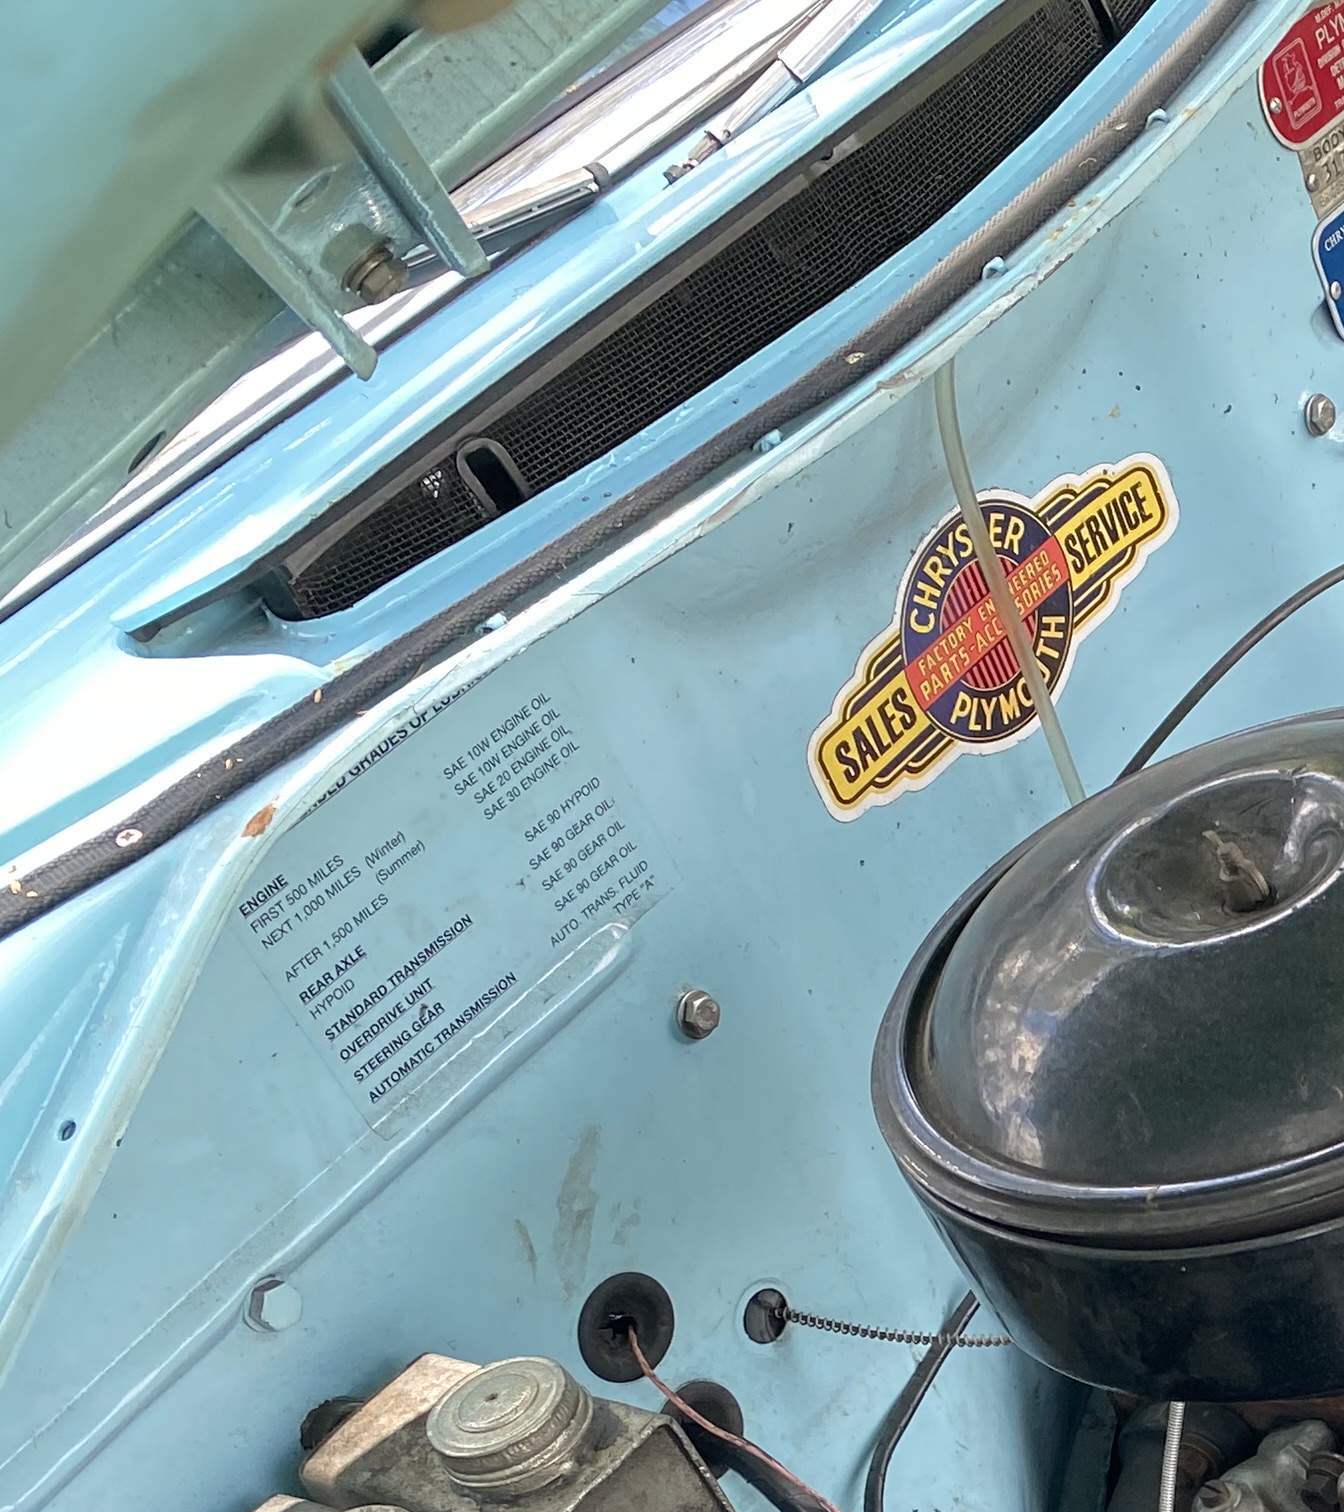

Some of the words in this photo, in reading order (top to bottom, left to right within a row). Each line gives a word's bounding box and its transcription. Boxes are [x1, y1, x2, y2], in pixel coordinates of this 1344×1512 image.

[1064, 481, 1153, 574] SERVICE
[911, 512, 1025, 634] CHRYSER
[917, 618, 974, 673] FACTORY
[978, 548, 1050, 623] ENNEERED
[443, 756, 468, 780] SAE
[467, 737, 491, 760] 10W
[490, 705, 532, 743] ENGINE
[531, 693, 551, 710] OIL
[454, 772, 478, 795] SAE
[478, 753, 501, 776] 10W
[501, 721, 542, 759] ENGINE
[541, 709, 561, 726] OIL
[474, 781, 498, 804] SAE
[496, 770, 511, 786] 20
[510, 737, 552, 775] ENGINE
[550, 725, 570, 743] OIL
[834, 688, 918, 784] SALES
[483, 797, 507, 820] SAE
[506, 786, 520, 802] 30
[520, 754, 561, 791] ENGINE
[560, 741, 580, 758] OIL
[524, 820, 548, 843] SAE
[546, 809, 561, 825] 90
[560, 777, 601, 814] HYPOID
[376, 840, 425, 885] (Summer)
[529, 848, 552, 871] SAE
[551, 837, 566, 853] 90
[565, 812, 596, 841] GEAR
[594, 799, 614, 817] OIL
[541, 869, 565, 891] SAE
[563, 857, 578, 873] 90
[577, 833, 608, 861] GEAR
[606, 820, 626, 838] OIL
[238, 874, 288, 918] ENGINE
[250, 901, 285, 933] FIRST
[285, 884, 308, 906] 500
[307, 855, 344, 888] MILES
[261, 918, 293, 949] NEXT
[295, 895, 325, 923] 1,000
[325, 866, 361, 899] MILES
[364, 831, 406, 869] (Winter)
[554, 889, 578, 912] SAE
[575, 878, 590, 894] 90
[589, 854, 620, 883] GEAR
[618, 841, 638, 858] OIL
[580, 887, 619, 920] TRANS.
[618, 860, 648, 890] FLUID
[612, 888, 641, 915] TYPE
[285, 947, 323, 982] AFTER
[323, 922, 353, 949] 1,500
[353, 894, 389, 926] MILES
[300, 972, 334, 1005] REAR
[337, 945, 366, 978] AXLE
[325, 985, 388, 1041] STANDARD
[387, 914, 473, 987] TRANSMISSION
[309, 979, 355, 1019] HYPOID
[340, 1004, 406, 1062] OVERDRIVE
[405, 978, 434, 1005] UNIT
[368, 1043, 434, 1103] AUTOMATIC
[434, 972, 518, 1045] TRANSMISSION
[354, 1031, 411, 1083] STEERING
[412, 1002, 445, 1033] GEAR
